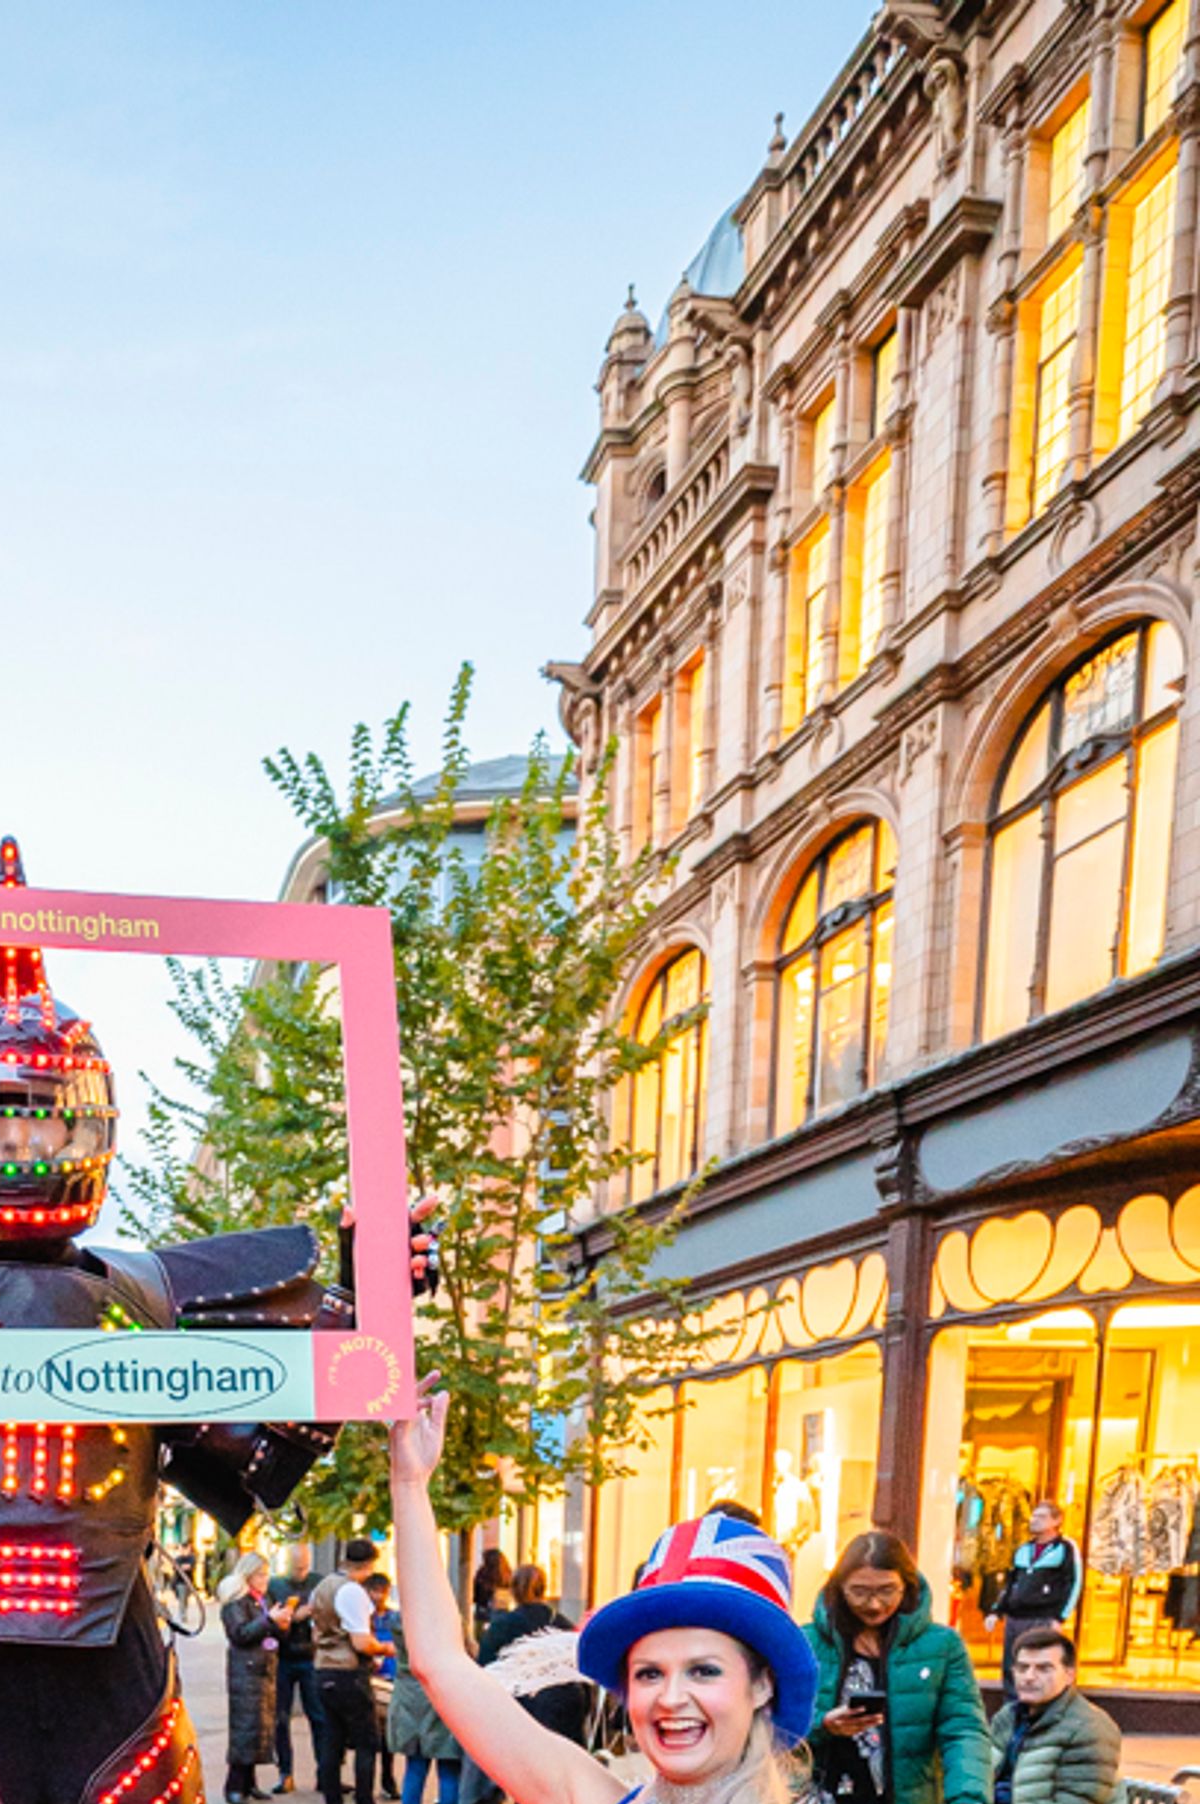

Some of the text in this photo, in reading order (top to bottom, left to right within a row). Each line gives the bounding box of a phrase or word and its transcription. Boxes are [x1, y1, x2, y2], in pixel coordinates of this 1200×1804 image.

[0, 1361, 36, 1393] to
[46, 1357, 275, 1400] Nottingham
[339, 1336, 401, 1414] NOTTINGHAM
